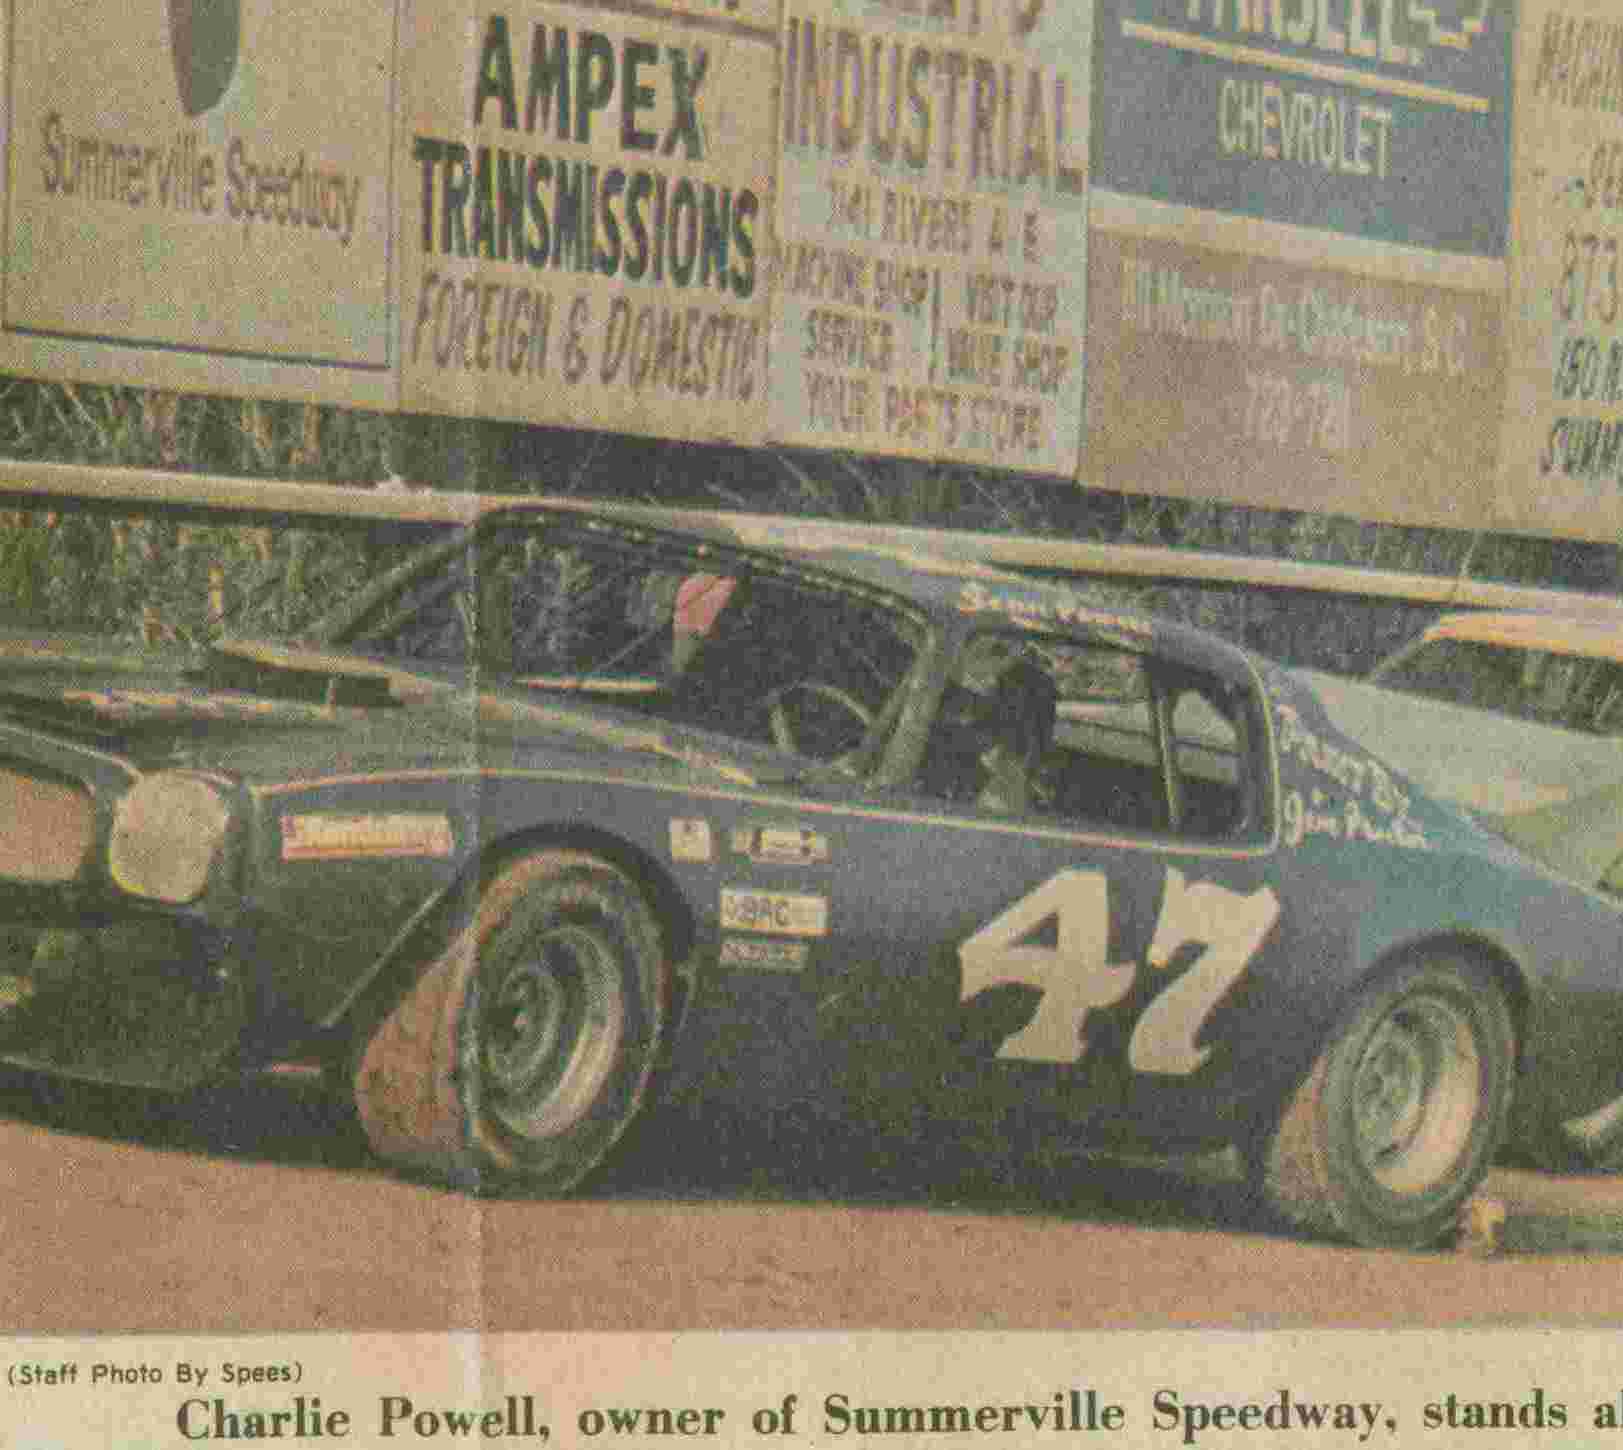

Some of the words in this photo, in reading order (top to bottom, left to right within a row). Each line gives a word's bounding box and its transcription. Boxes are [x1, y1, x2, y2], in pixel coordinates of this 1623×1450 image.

[472, 15, 707, 160] AMPEX
[784, 18, 1083, 194] INDUSTRIAL
[1217, 77, 1392, 180] CHEVROLET
[40, 110, 214, 214] Summerville
[224, 135, 359, 248] Speedway
[411, 135, 758, 298] TRANSMISSIONS
[412, 272, 552, 382] FOREIGN
[563, 296, 588, 385] &
[600, 296, 766, 402] DOMESTIC
[957, 866, 1281, 1075] 47
